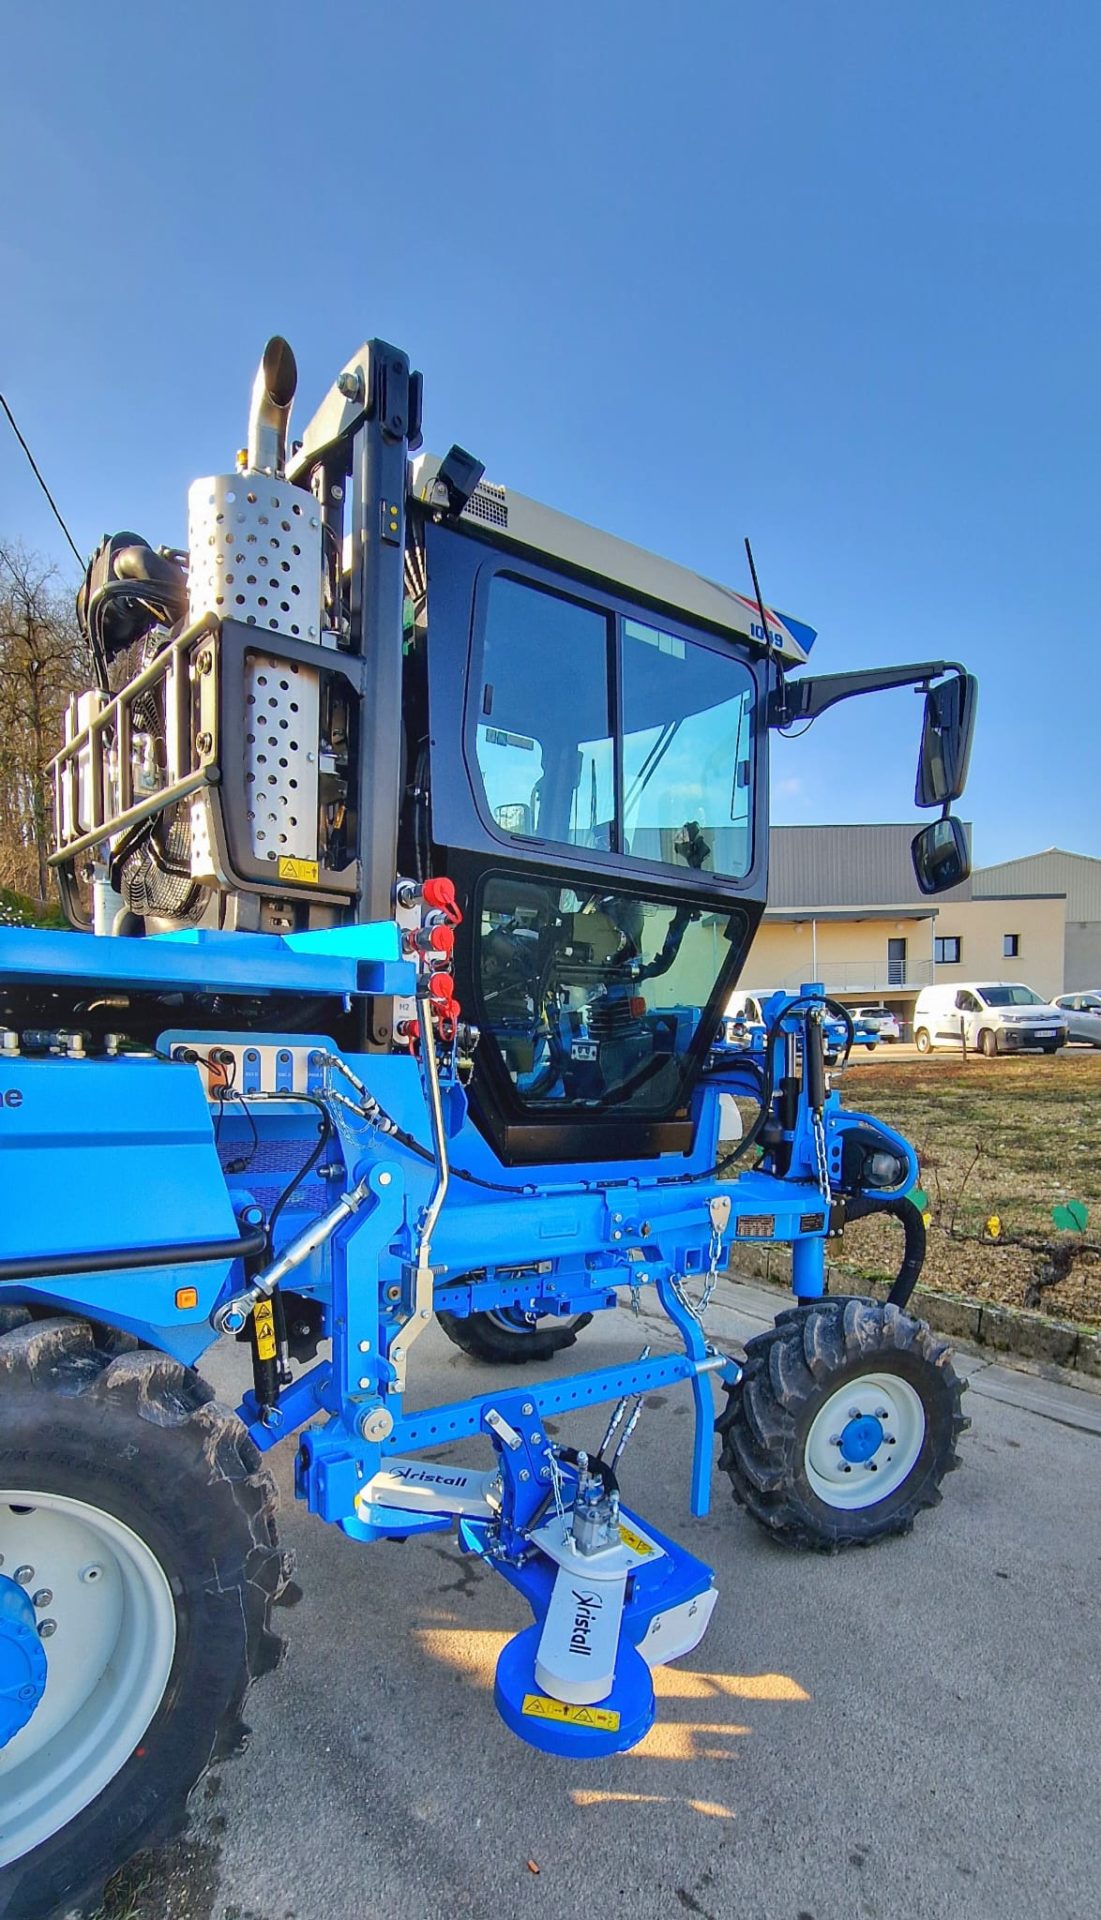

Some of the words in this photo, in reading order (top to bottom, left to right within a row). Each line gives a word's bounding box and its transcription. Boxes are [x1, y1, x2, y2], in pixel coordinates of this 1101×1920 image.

[0, 1089, 23, 1107] e
[389, 1466, 468, 1487] Kristall
[569, 1590, 603, 1656] Kristall
